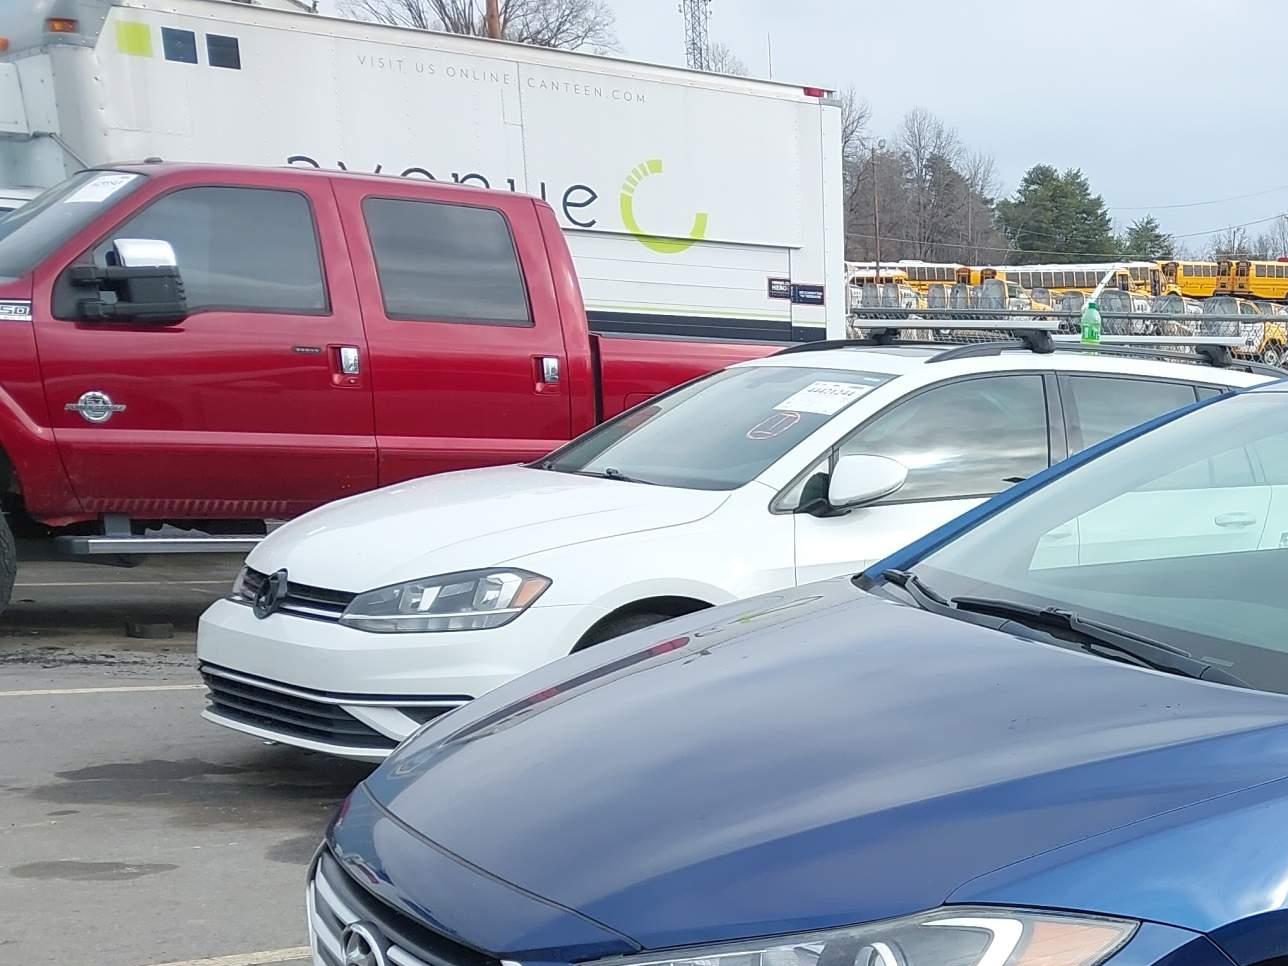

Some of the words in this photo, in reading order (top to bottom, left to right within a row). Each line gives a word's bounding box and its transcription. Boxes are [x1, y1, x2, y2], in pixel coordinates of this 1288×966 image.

[357, 56, 403, 71] VISIT
[415, 63, 435, 75] US
[527, 77, 646, 103] CANTEEN.COM
